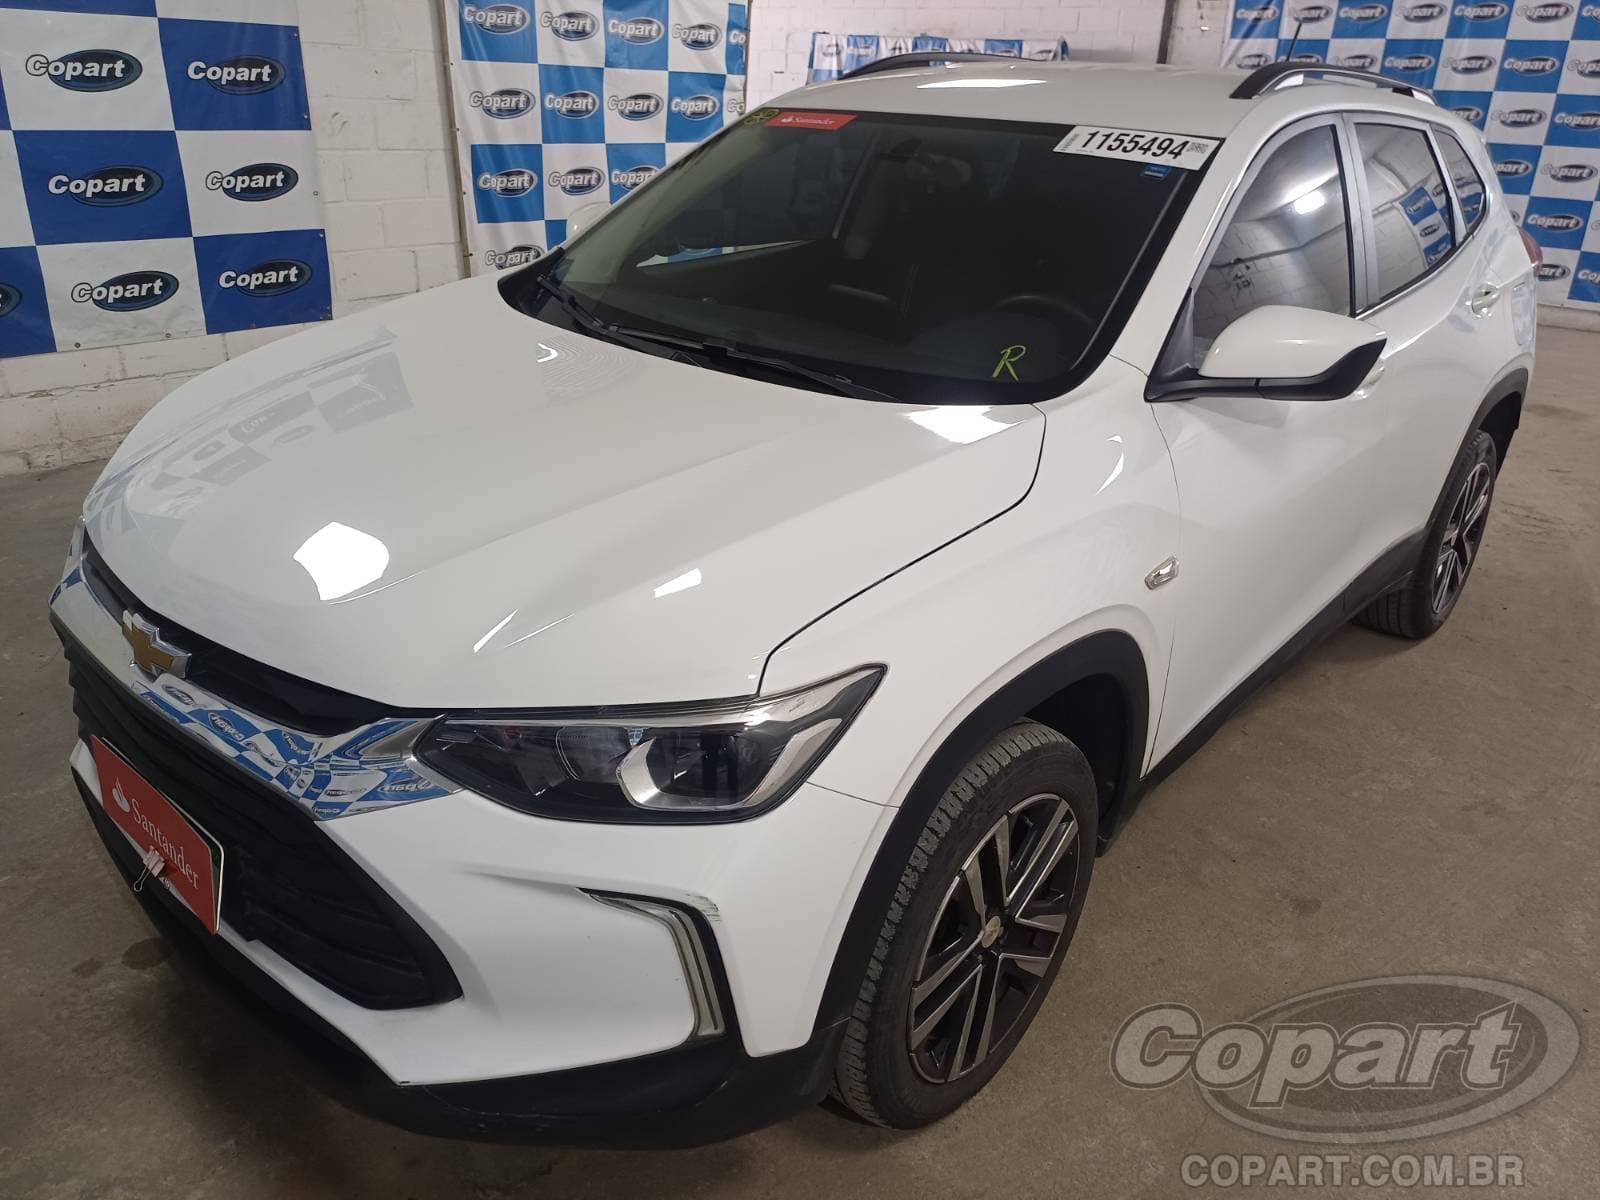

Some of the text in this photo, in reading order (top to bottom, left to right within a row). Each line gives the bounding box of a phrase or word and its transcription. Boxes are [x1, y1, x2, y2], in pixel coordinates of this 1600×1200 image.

[463, 4, 523, 27] Copart
[1339, 7, 1384, 19] Copart
[1454, 5, 1502, 18] Copart
[1516, 4, 1564, 18] Copart
[541, 11, 593, 34] Copart
[608, 19, 658, 39] Copart
[672, 23, 717, 45] Copart
[26, 54, 125, 80] Copart
[187, 61, 272, 85] Copart
[1385, 57, 1430, 70] Copart
[1503, 58, 1553, 71] Copart
[469, 91, 527, 113] Copart
[545, 95, 594, 112] Copart
[607, 96, 658, 114] Copart
[671, 97, 714, 114] Copart
[793, 115, 835, 126] Santander
[1081, 130, 1190, 160] 1155494
[48, 174, 147, 198] Copart
[205, 170, 284, 193] Copart
[479, 171, 531, 195] Copart
[549, 171, 599, 193] Copart
[1526, 213, 1578, 229] Copart
[485, 244, 540, 271] Copart
[218, 265, 298, 290] Copart
[71, 278, 163, 304] Copart
[992, 345, 1026, 381] R
[131, 798, 199, 890] Santander
